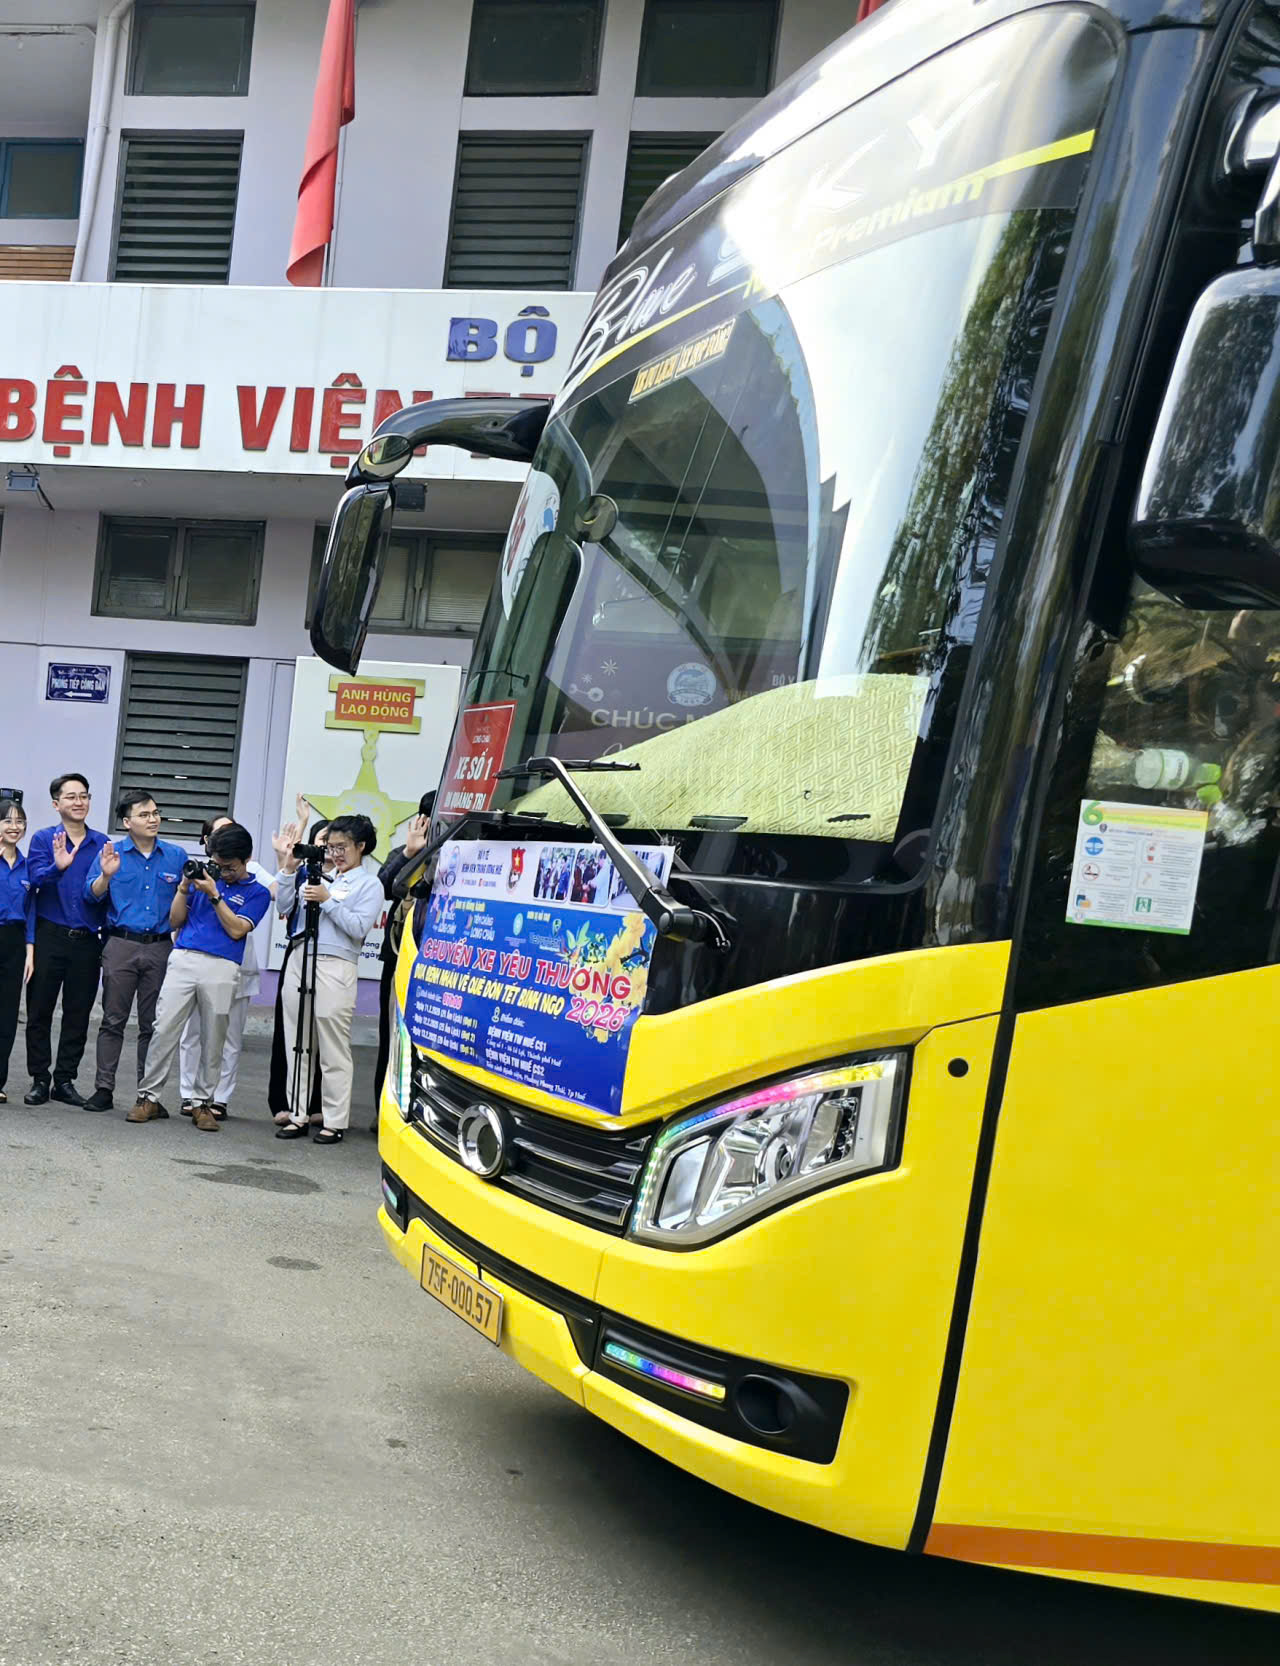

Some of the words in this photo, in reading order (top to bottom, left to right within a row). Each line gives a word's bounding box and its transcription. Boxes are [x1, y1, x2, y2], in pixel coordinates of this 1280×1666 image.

[447, 306, 557, 377] BỘ
[341, 688, 370, 701] ANH
[340, 703, 367, 716] LAO
[370, 704, 409, 721] ĐỘNG
[591, 707, 676, 731] CHÚC
[454, 756, 471, 780] XE
[467, 748, 489, 781] SỐ
[484, 757, 494, 781] 1
[423, 937, 473, 967] CHUYẾN
[473, 947, 498, 972] XE
[499, 949, 532, 981] YÊU
[535, 959, 632, 1000] THƯƠNG
[503, 982, 520, 1005] TẾT
[541, 994, 566, 1020] NGỌ
[565, 996, 629, 1032] 2026
[535, 1039, 547, 1052] CS1
[532, 1063, 545, 1076] CS2
[428, 1256, 493, 1329] 75F-000.57
